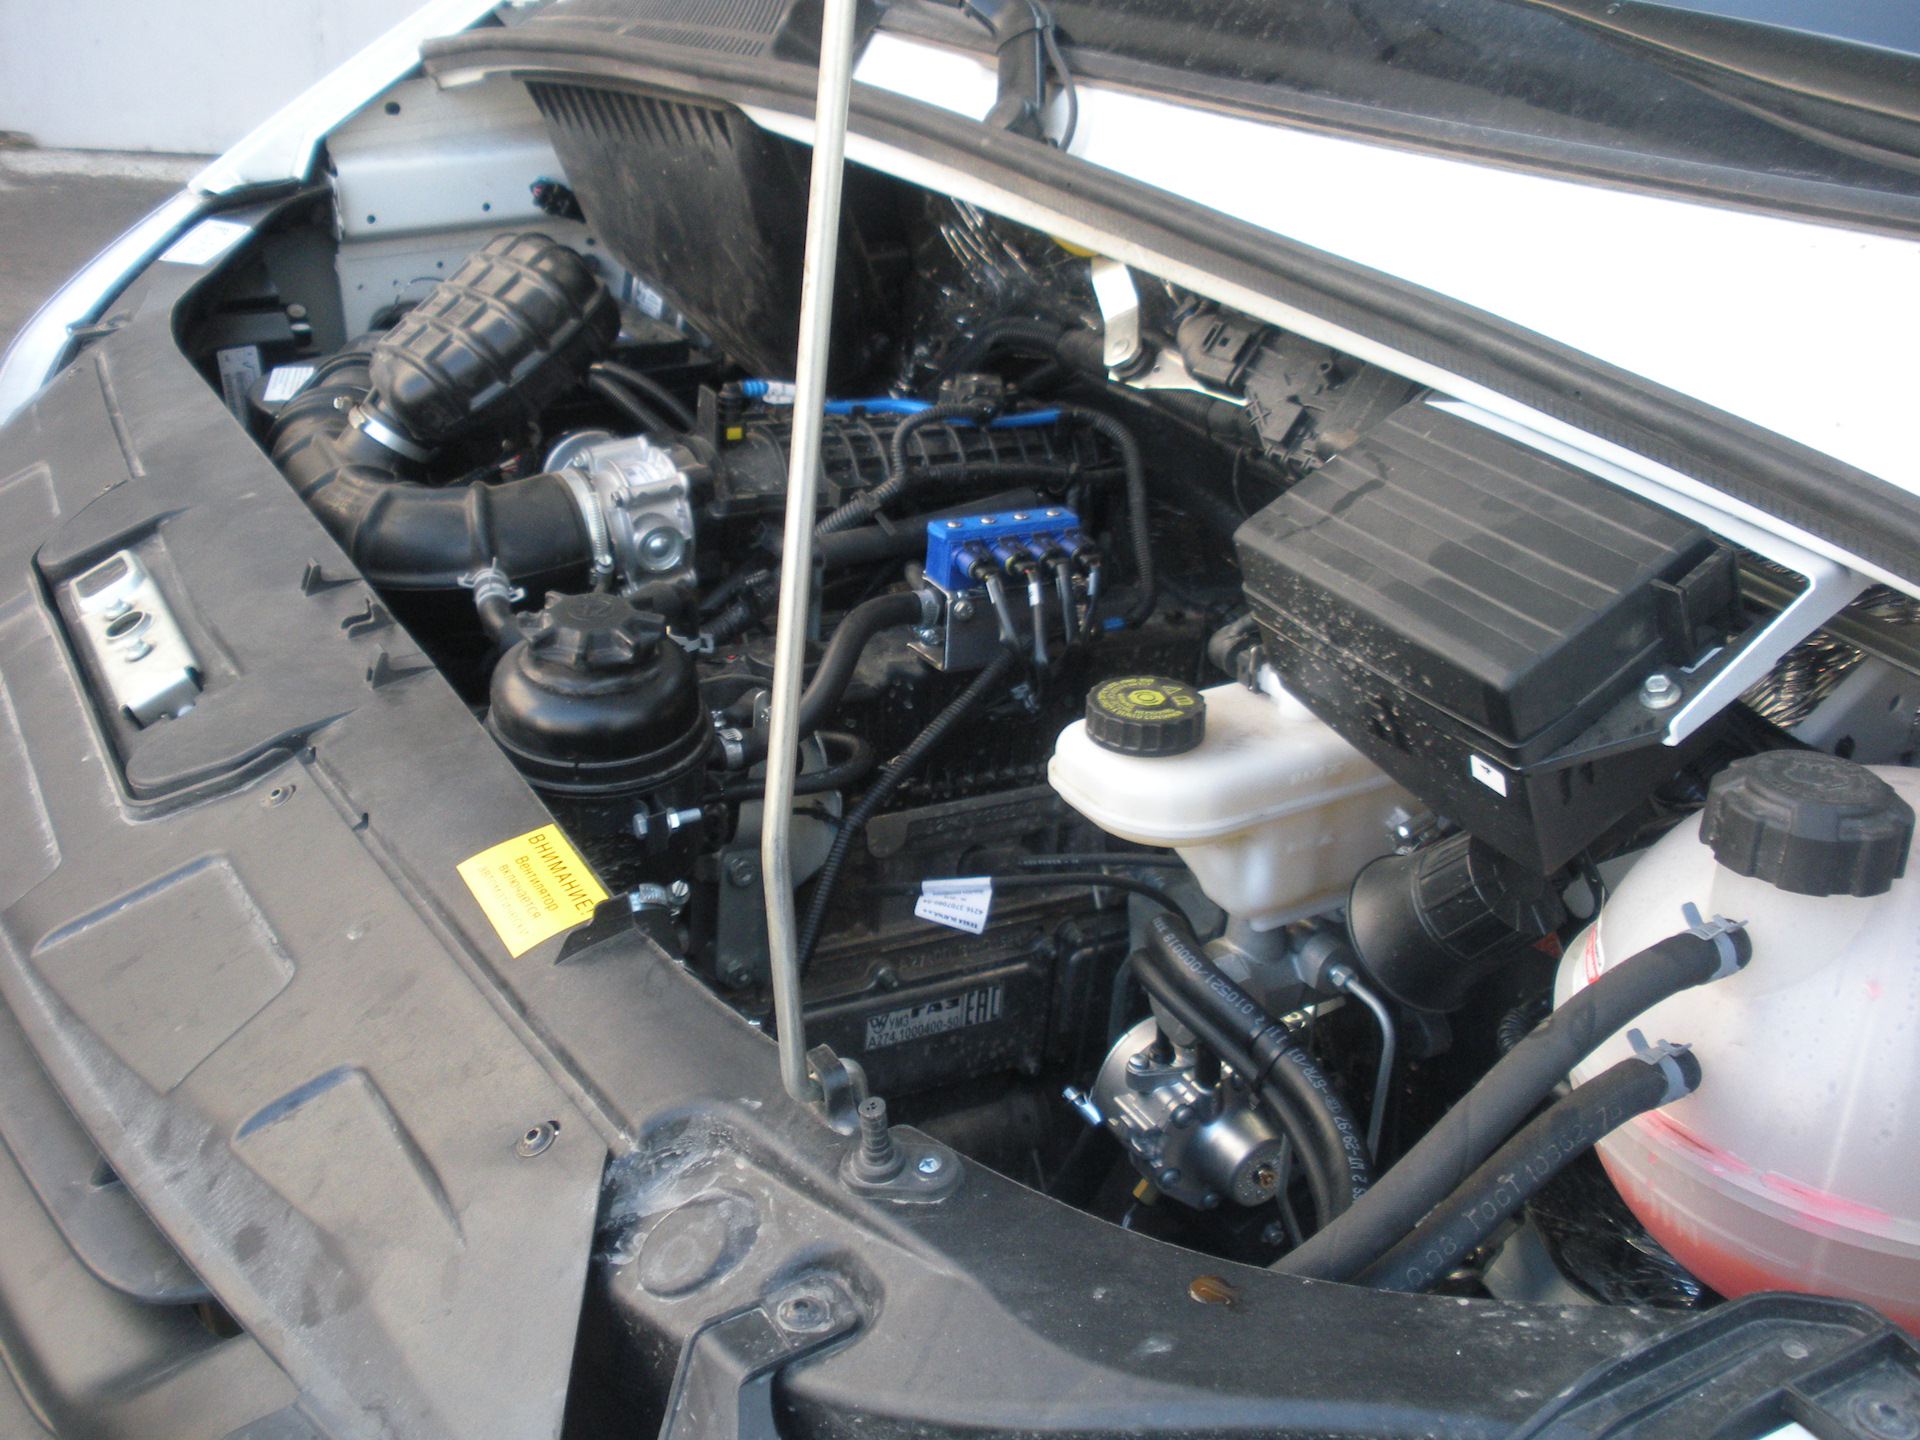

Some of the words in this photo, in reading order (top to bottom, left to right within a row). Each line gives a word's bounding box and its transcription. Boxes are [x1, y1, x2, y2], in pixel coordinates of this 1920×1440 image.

[498, 864, 542, 920] включается
[515, 855, 559, 912] Вентилятор
[528, 833, 594, 916] ВНИМАНИЕ!
[911, 998, 960, 1018] ГАЗ
[1462, 1173, 1521, 1231] ГОСТ
